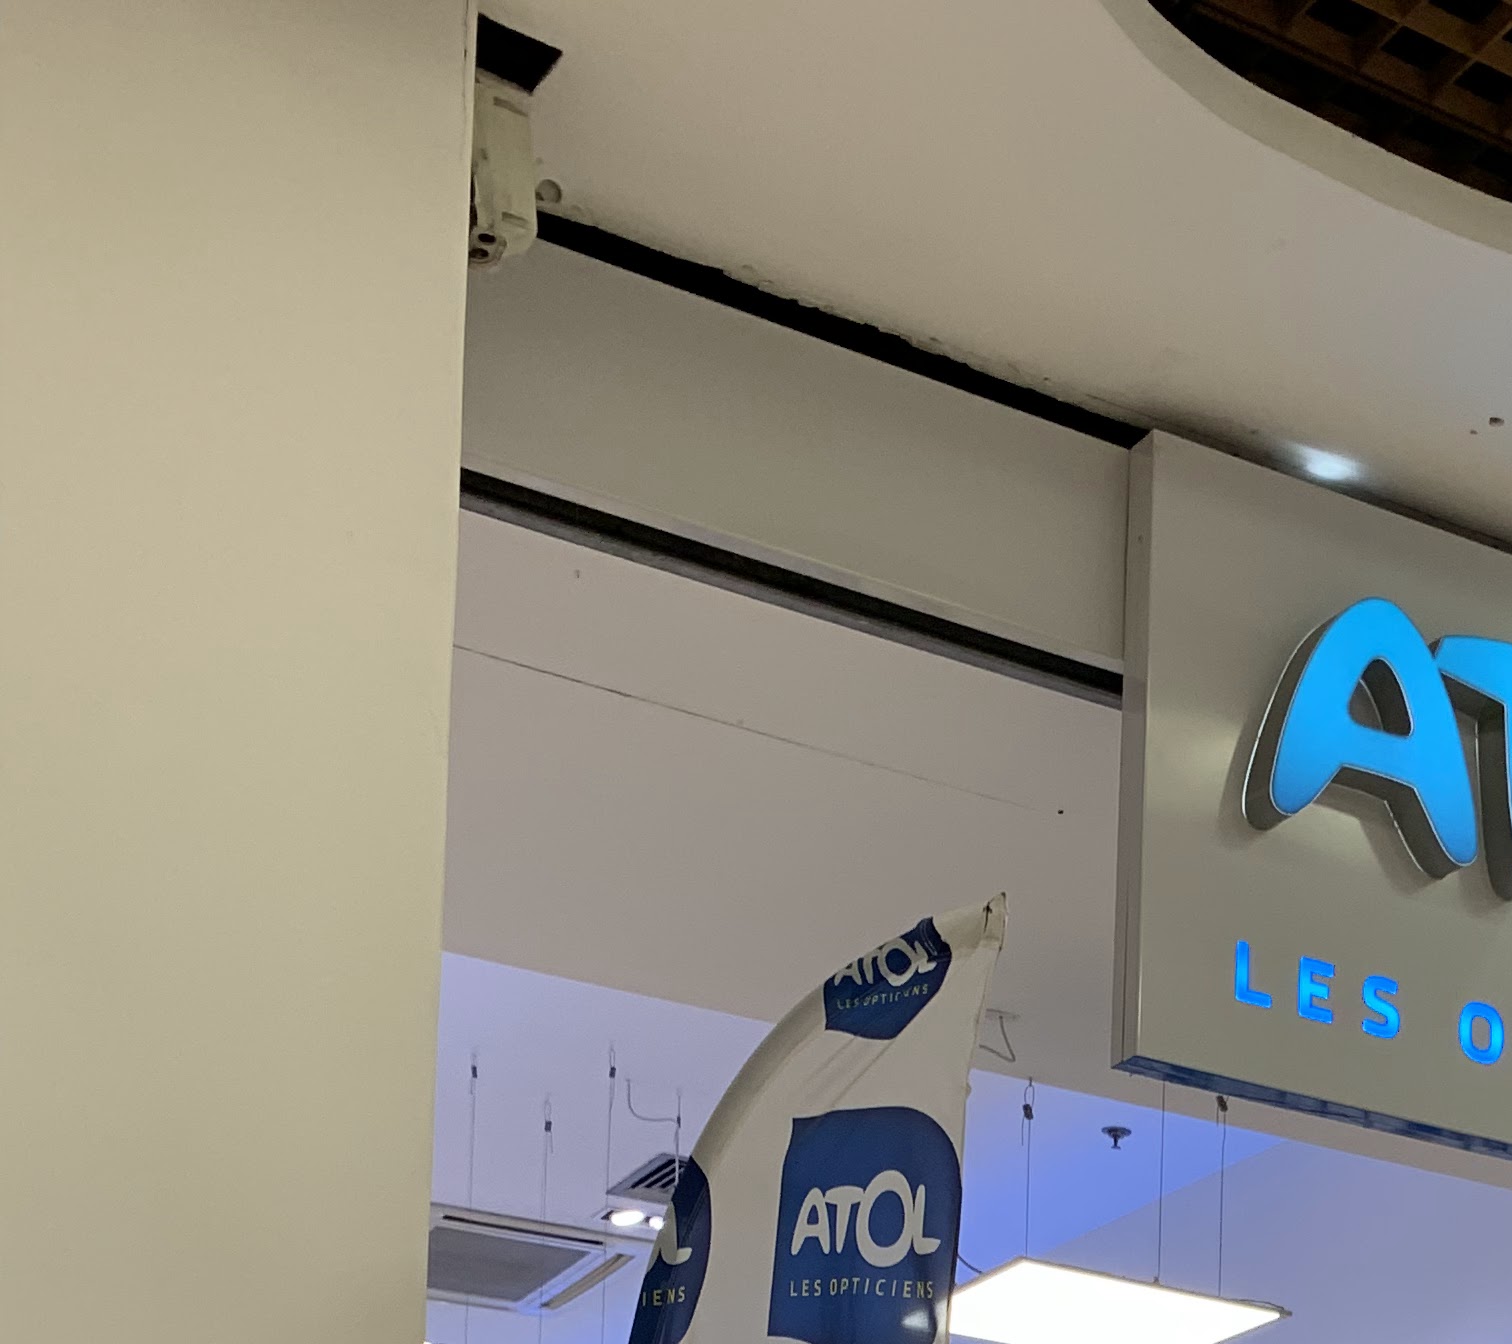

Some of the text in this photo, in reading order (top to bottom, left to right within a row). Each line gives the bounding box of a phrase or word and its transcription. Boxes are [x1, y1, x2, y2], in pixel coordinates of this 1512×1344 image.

[1235, 941, 1400, 1039] LES
[791, 1170, 941, 1268] ATOL
[790, 1277, 934, 1299] LES OPTICIENS
